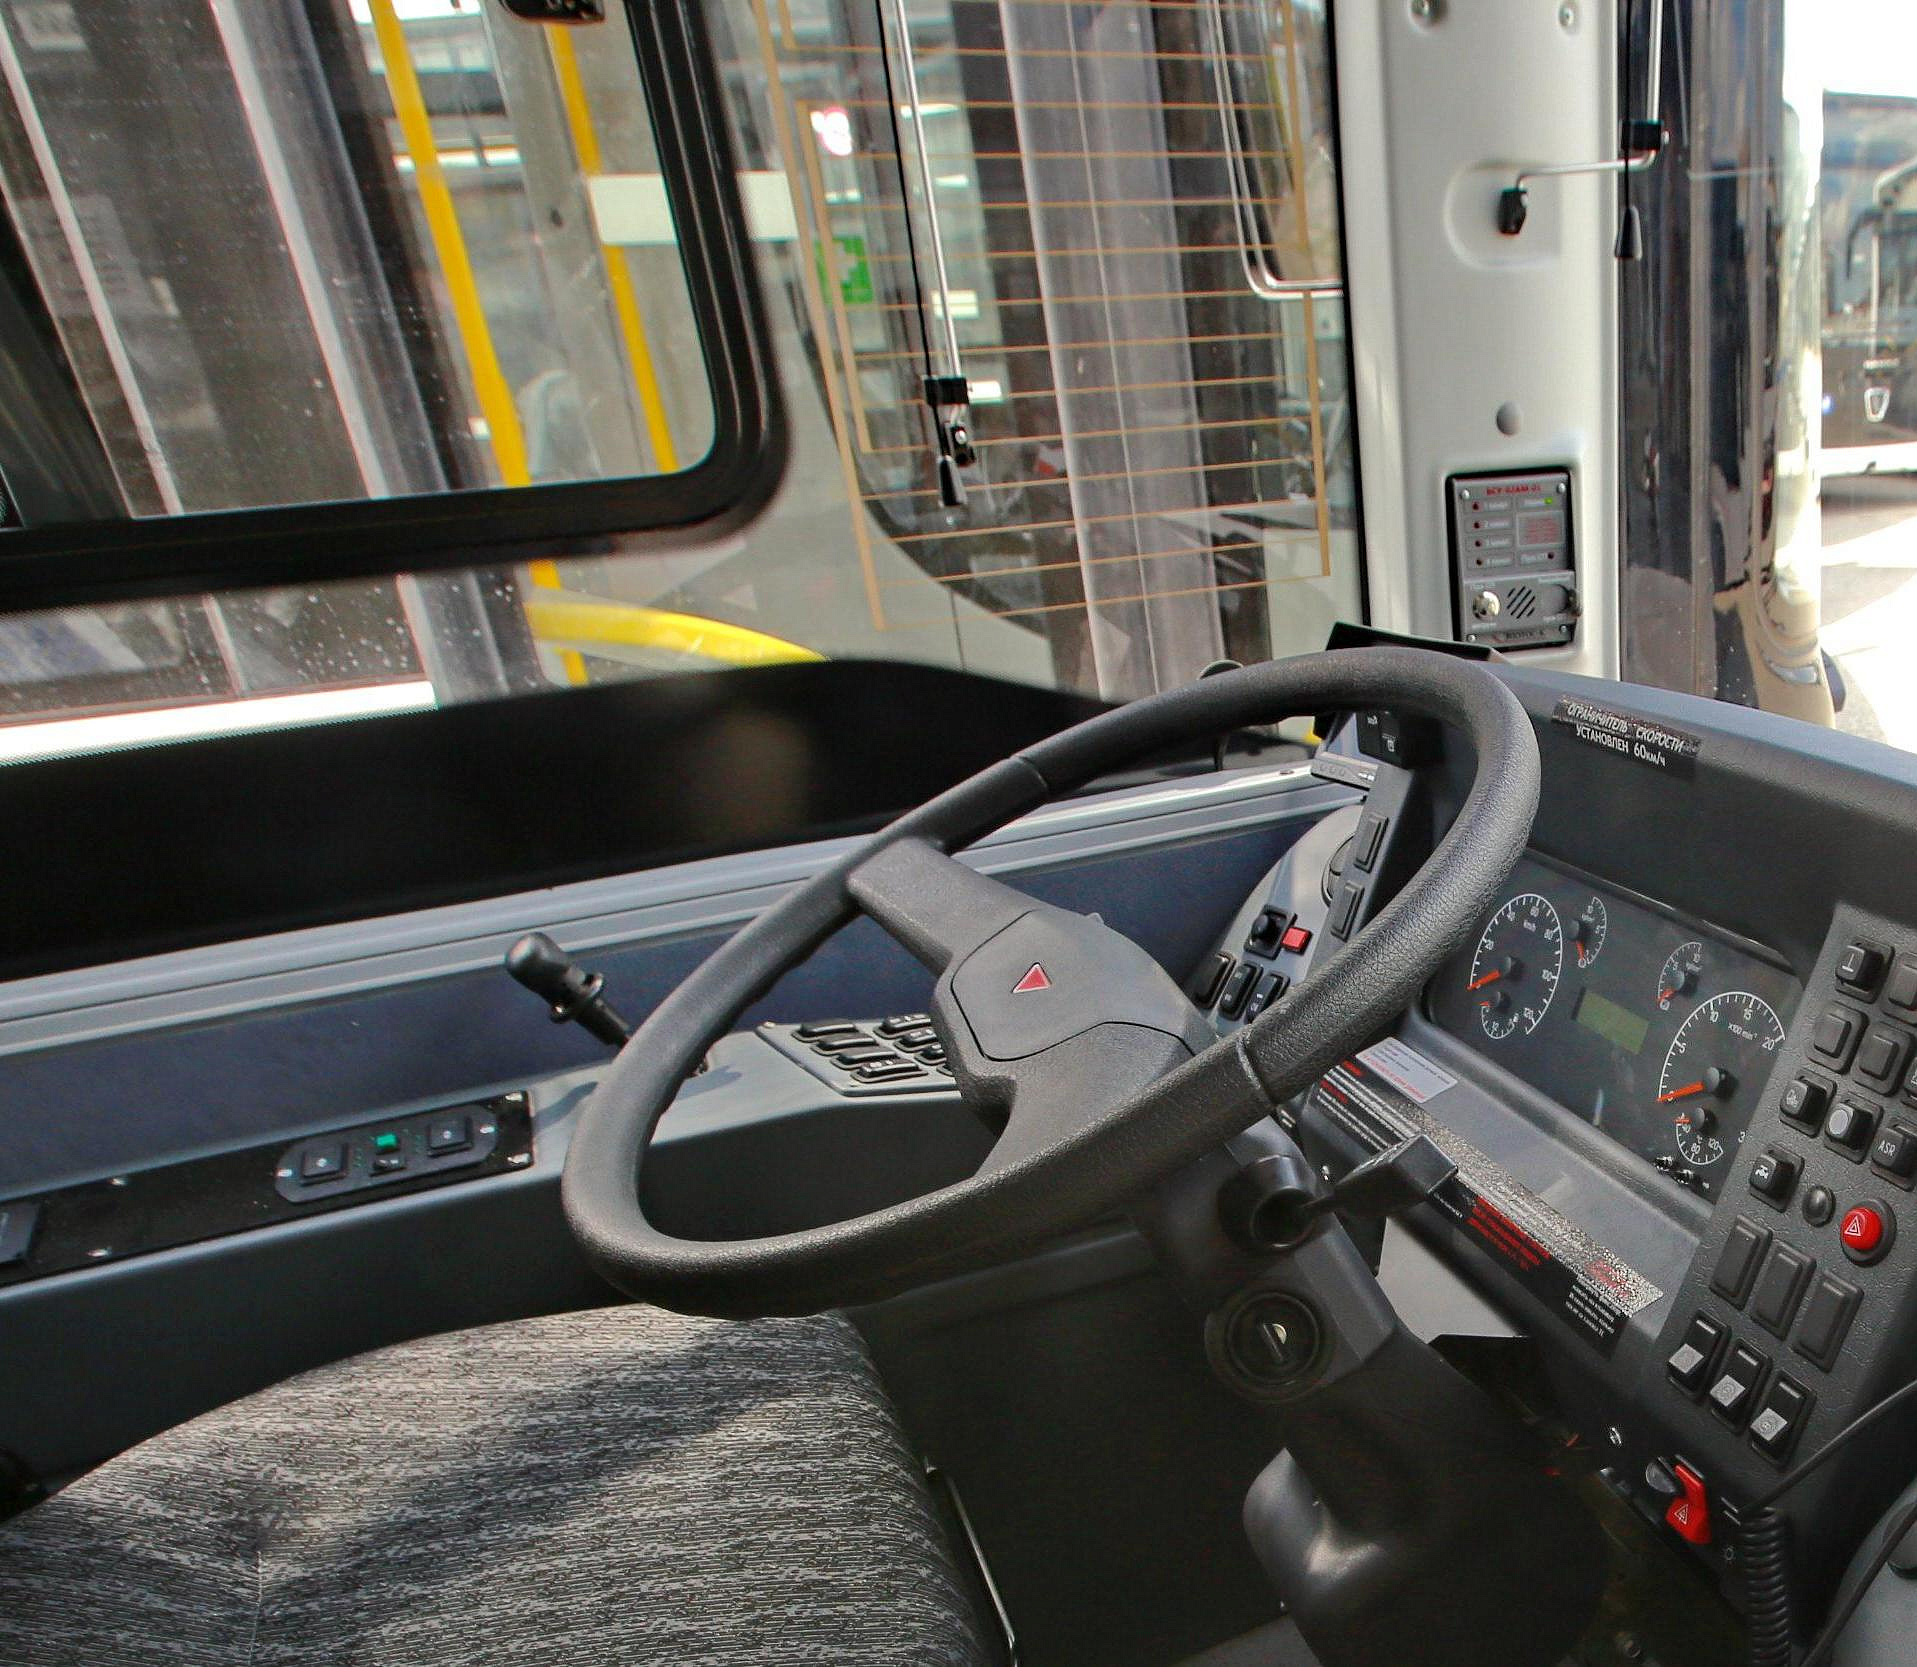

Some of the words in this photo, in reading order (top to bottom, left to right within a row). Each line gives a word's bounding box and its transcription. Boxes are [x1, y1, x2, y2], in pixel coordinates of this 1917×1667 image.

[1567, 702, 1628, 733] ОГРАНИЧИТЕЛЬ
[1635, 726, 1685, 753] СКОРОСТИ
[1576, 724, 1629, 754] УСТАНОВЛЕН
[1634, 742, 1666, 767] 60км/ч
[1709, 1010, 1719, 1023] 10
[1743, 1008, 1753, 1021] 15
[1680, 1041, 1687, 1054] 5
[1762, 1036, 1775, 1051] 20
[1690, 1142, 1701, 1155] 80
[1708, 1138, 1720, 1151] 120
[1877, 1139, 1896, 1157] ASR
